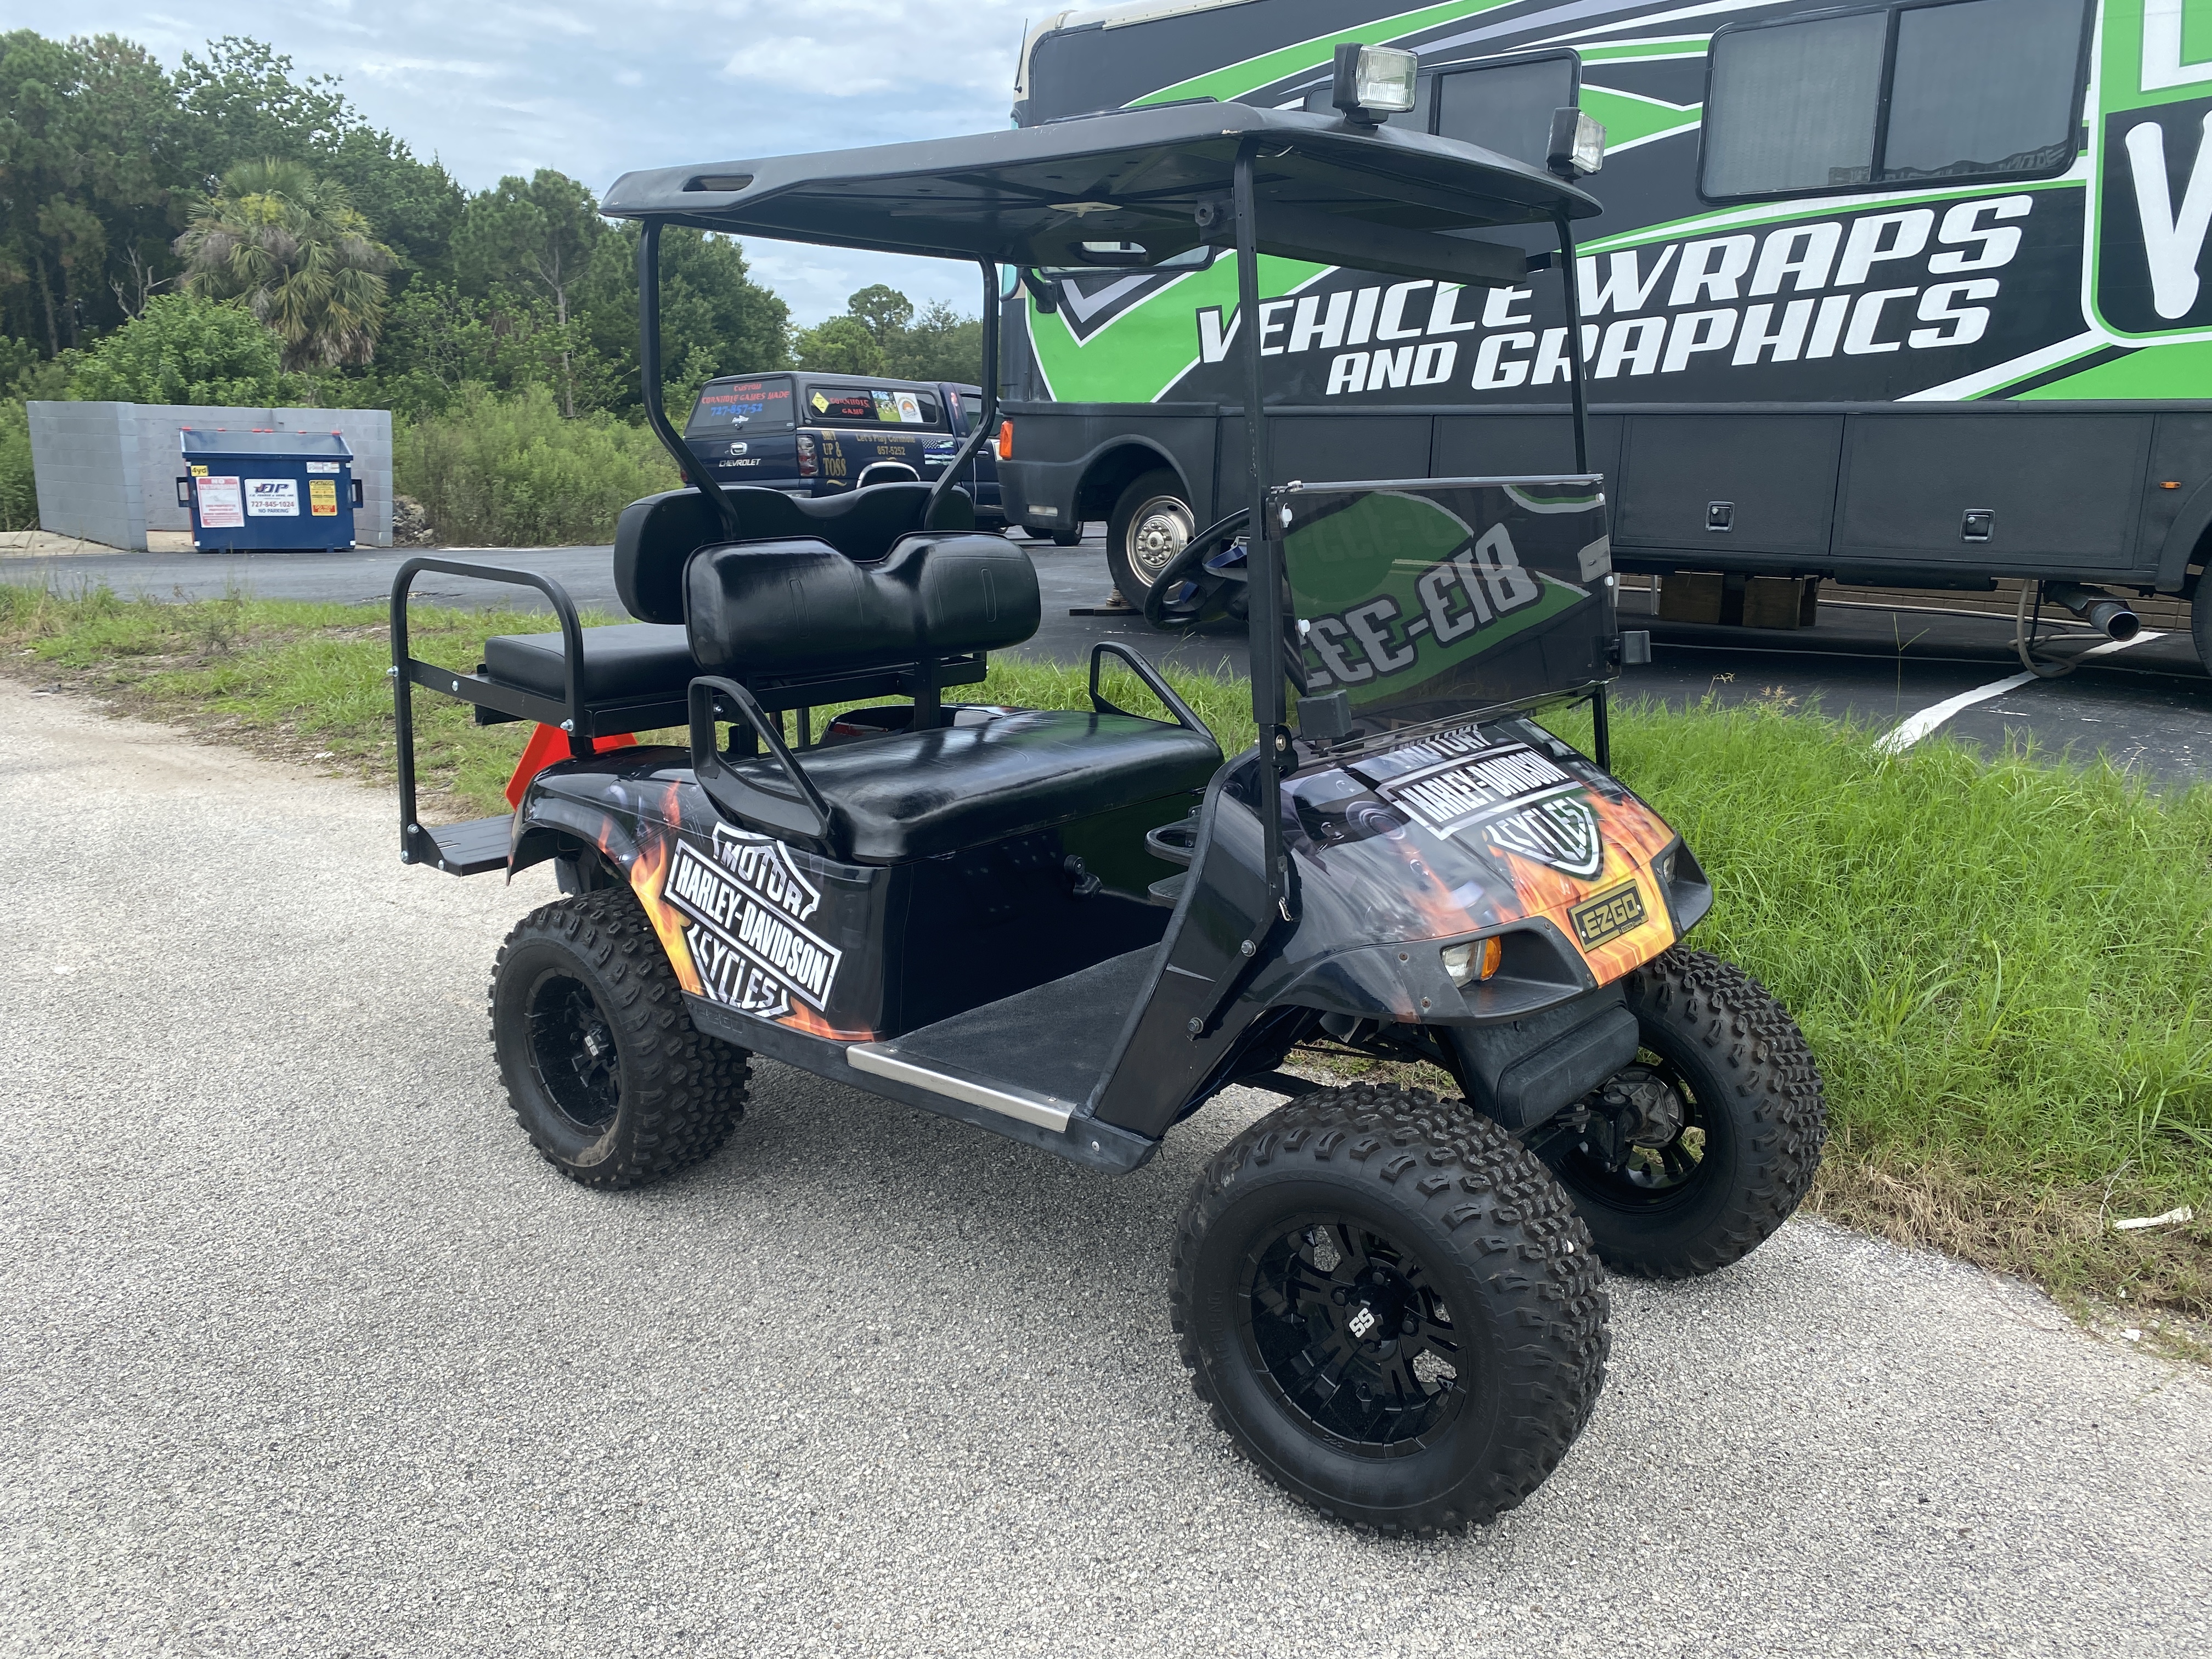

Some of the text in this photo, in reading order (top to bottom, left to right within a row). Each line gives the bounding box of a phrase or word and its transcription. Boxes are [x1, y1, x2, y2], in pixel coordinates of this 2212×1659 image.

[1200, 195, 2033, 363] VEHICLE WRAPS
[1325, 278, 2000, 395] AND GRAPHICS
[740, 392, 766, 401] GAMES
[767, 391, 790, 400] MADE
[823, 441, 843, 458] UP &
[873, 434, 887, 444] Play
[888, 435, 916, 443] Cornhole
[877, 445, 905, 456] 857-5252
[192, 467, 207, 475] 4yd
[719, 458, 761, 467] CHEVROLET
[823, 458, 847, 477] TOSS
[1398, 751, 1570, 822] HARLEY-DAVIDSON
[720, 840, 803, 917] MOTOR
[675, 854, 830, 995] HARLEY-DAVIDSON
[1582, 893, 1639, 939] EZGO
[699, 930, 778, 1009] CYCLES
[1349, 1307, 1375, 1338] SS
